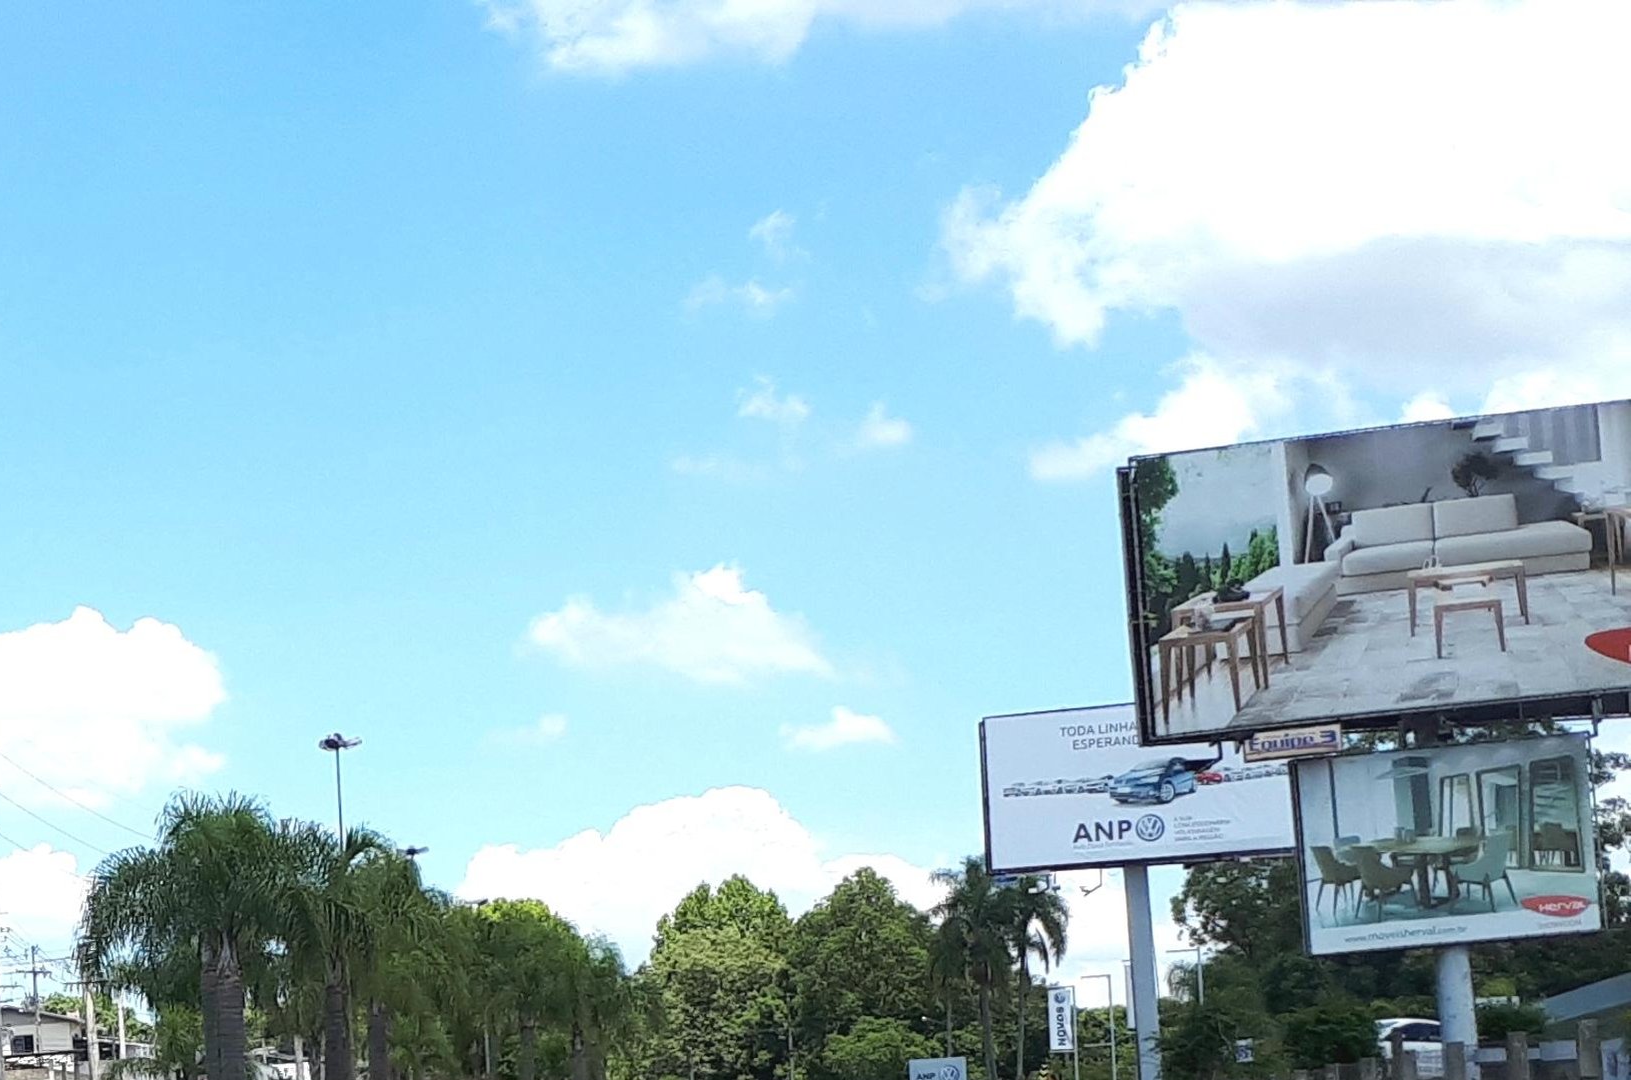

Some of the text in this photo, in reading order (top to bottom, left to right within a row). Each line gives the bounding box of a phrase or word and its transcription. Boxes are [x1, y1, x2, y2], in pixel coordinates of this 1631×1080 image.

[1060, 725, 1095, 737] TODA
[1319, 730, 1337, 743] 3
[1073, 819, 1132, 843] ANP
